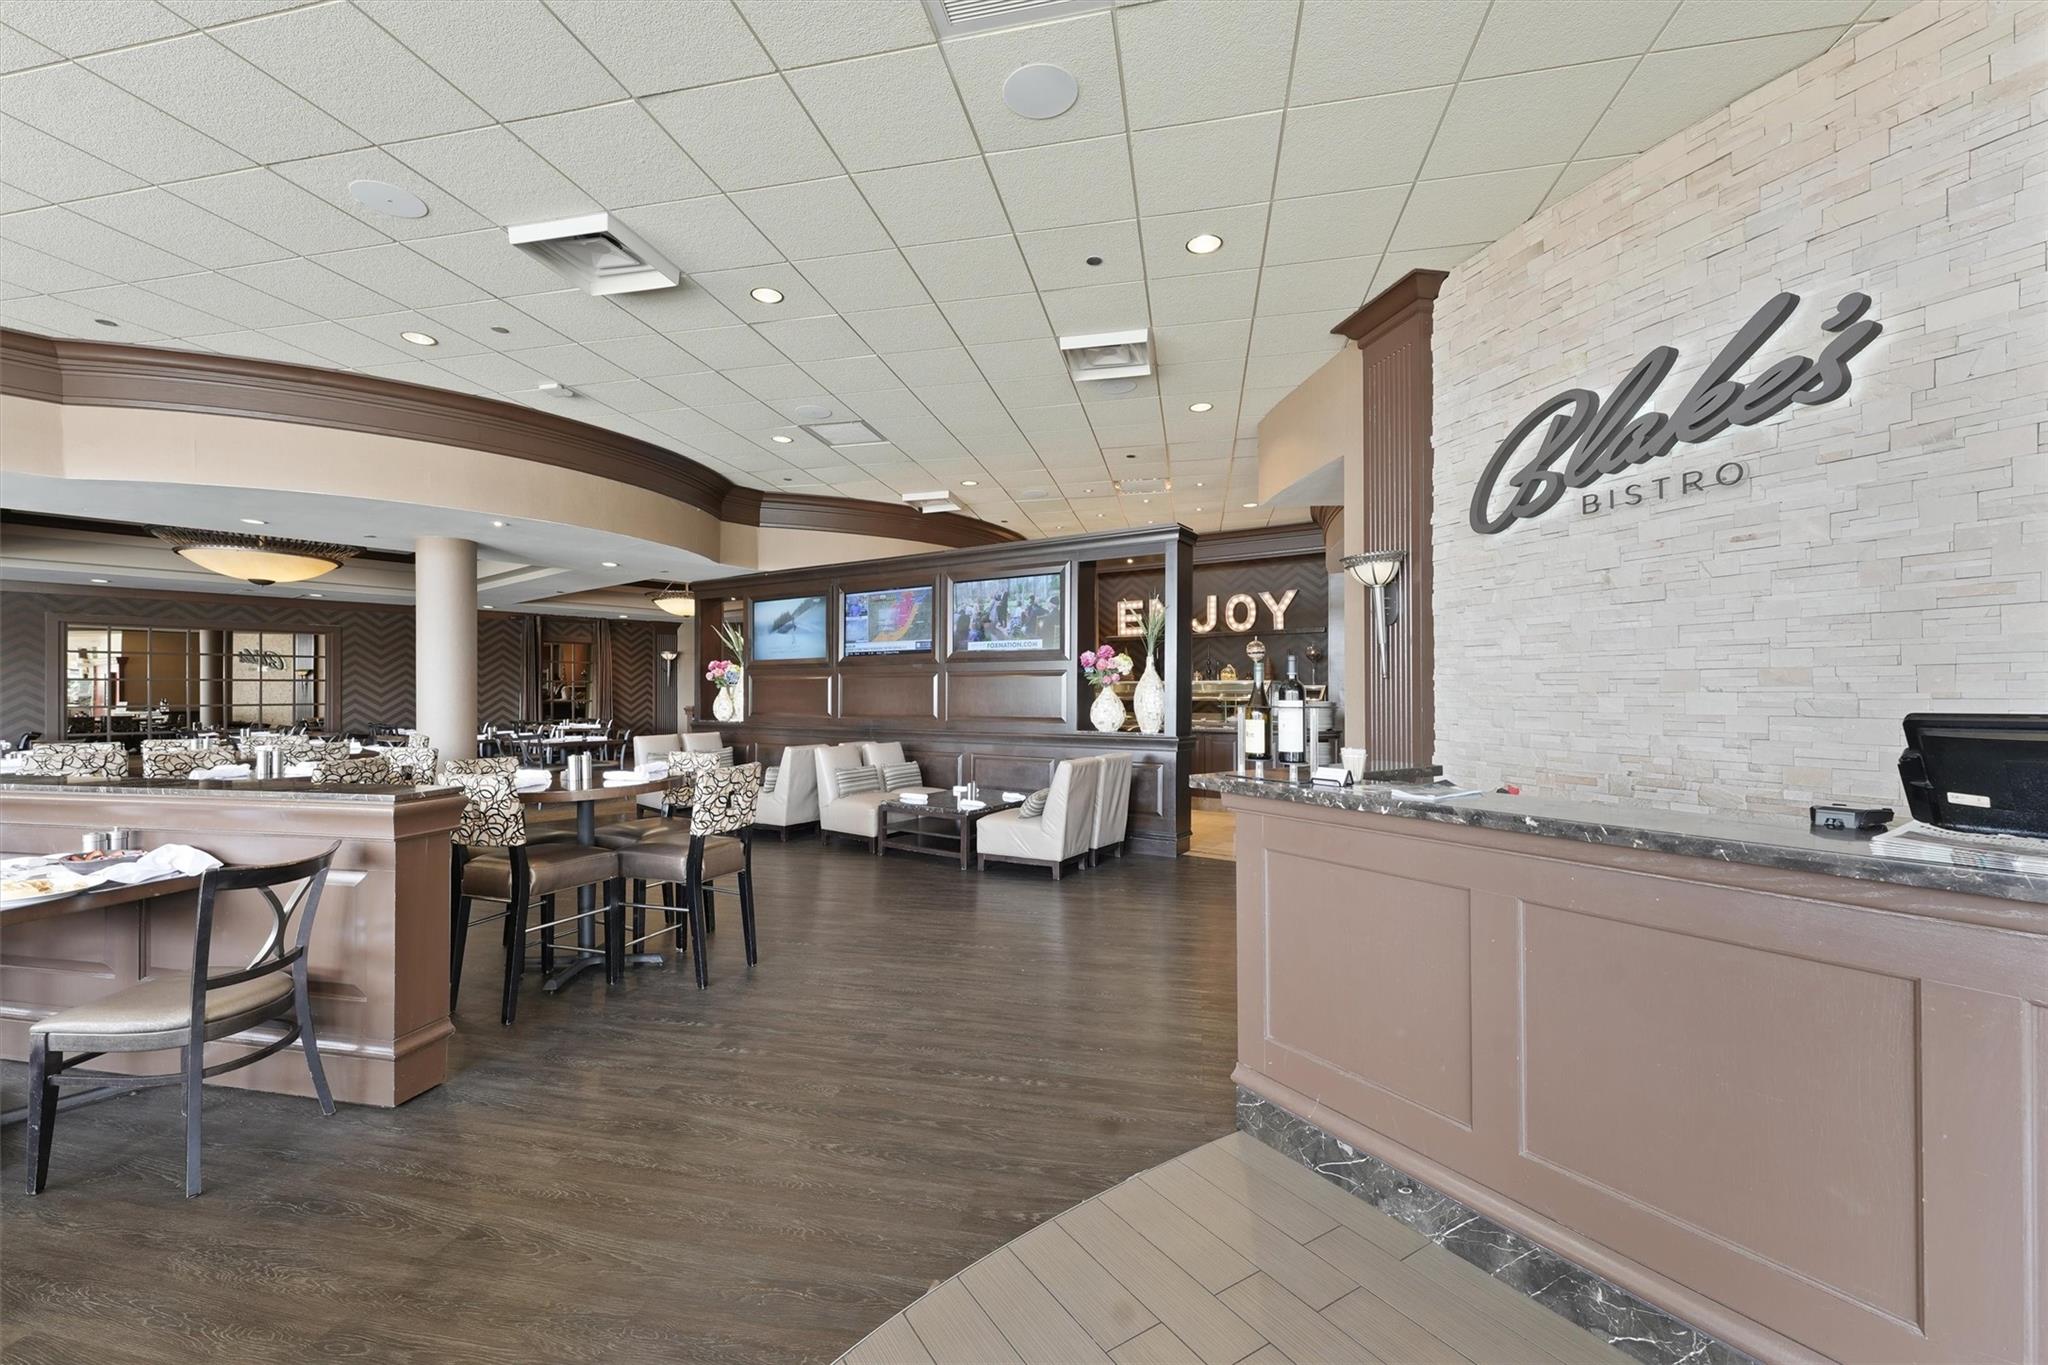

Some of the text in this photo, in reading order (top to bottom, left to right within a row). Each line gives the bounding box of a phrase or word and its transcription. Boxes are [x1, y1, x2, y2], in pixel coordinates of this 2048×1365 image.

[1469, 291, 1883, 534] Blake's
[1581, 461, 1747, 515] BISTRO
[986, 641, 1038, 649] FOXNATION.COM
